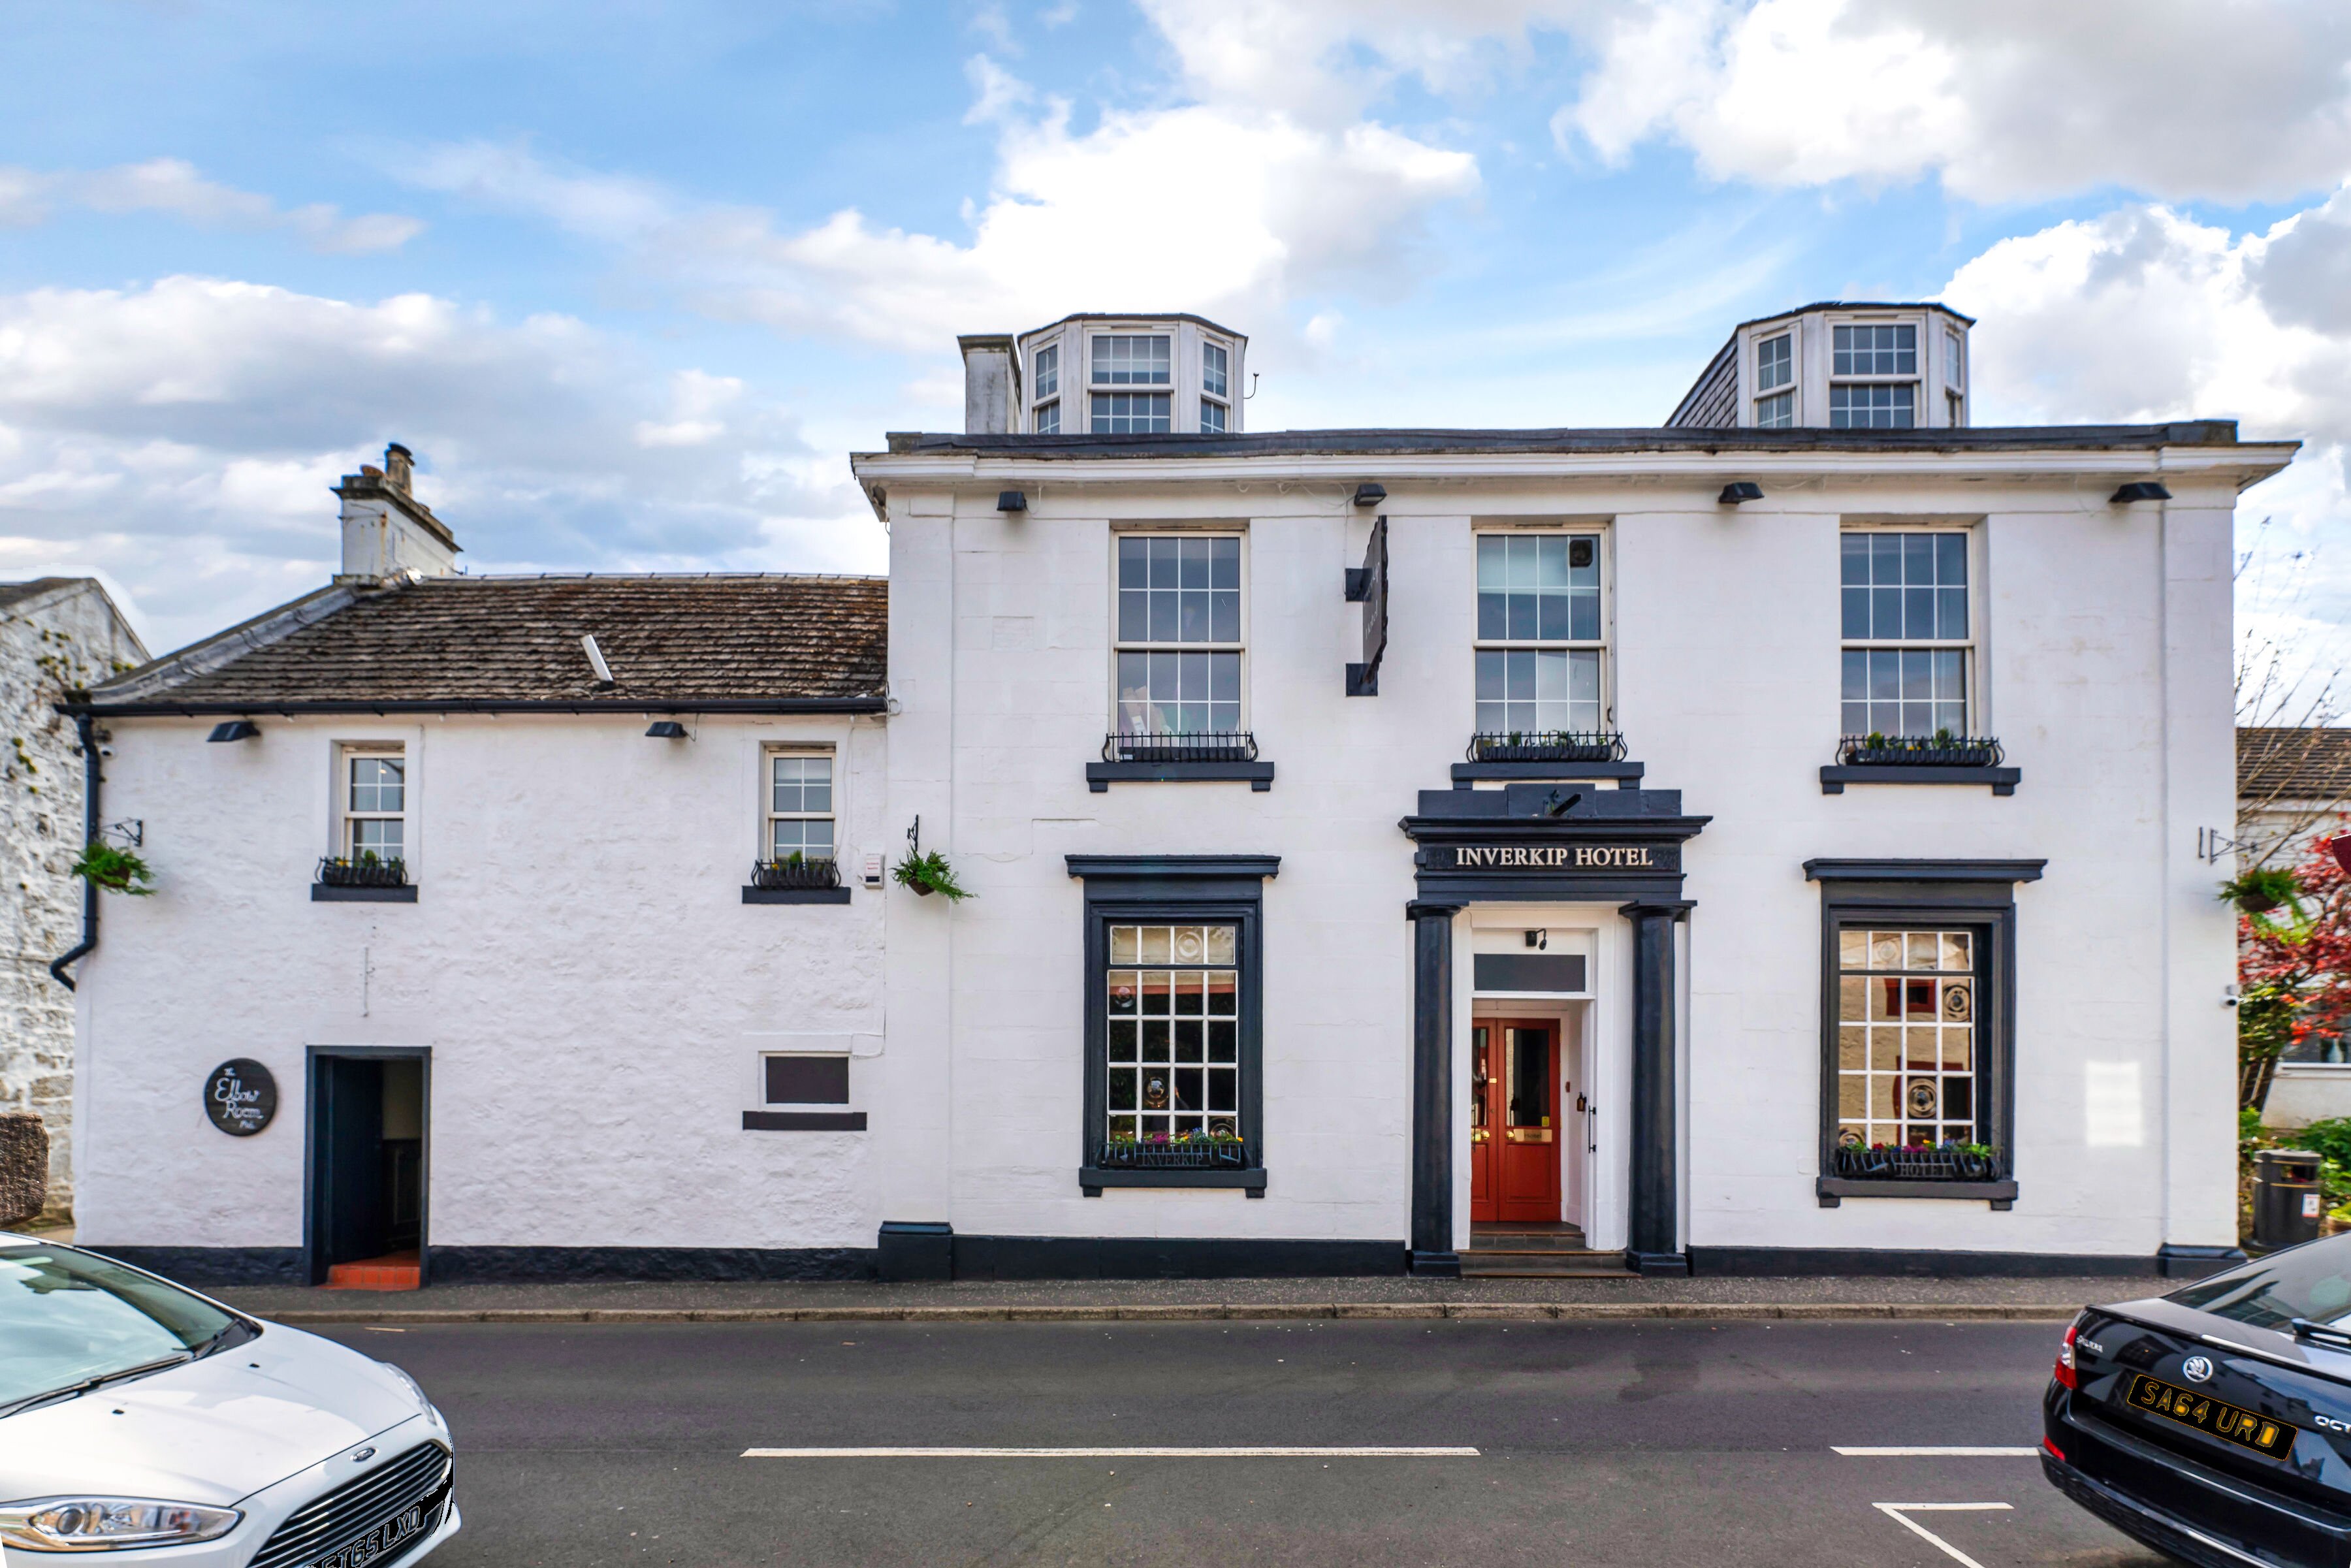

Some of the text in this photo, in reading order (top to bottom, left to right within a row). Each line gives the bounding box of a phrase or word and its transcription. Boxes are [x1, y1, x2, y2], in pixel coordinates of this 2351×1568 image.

[1456, 848, 1654, 867] INVERKIP HOTEL
[214, 1077, 261, 1102] Elbow
[1140, 1153, 1203, 1166] INVERKIP
[2141, 1381, 2280, 1448] SA64 URD
